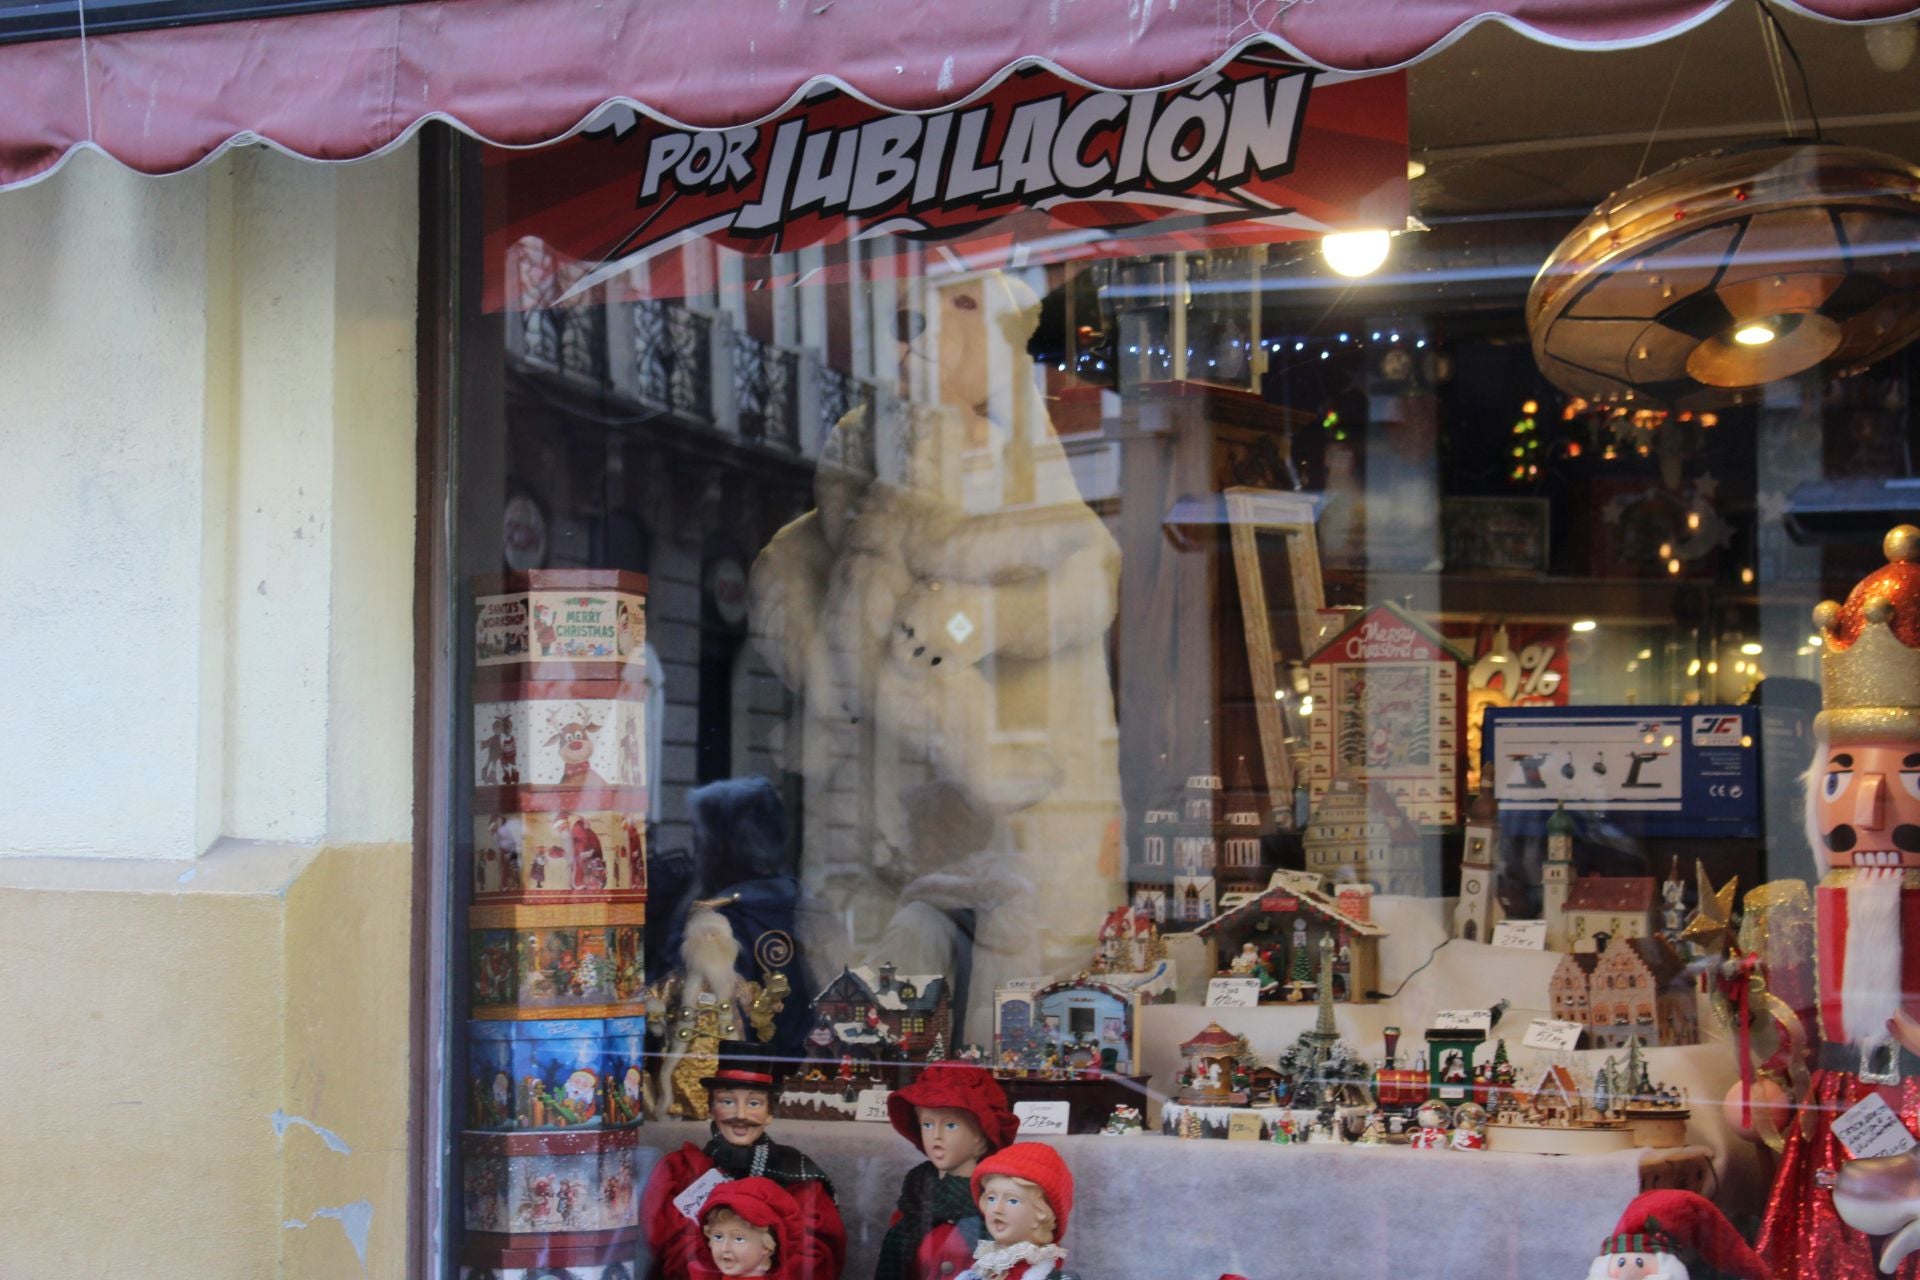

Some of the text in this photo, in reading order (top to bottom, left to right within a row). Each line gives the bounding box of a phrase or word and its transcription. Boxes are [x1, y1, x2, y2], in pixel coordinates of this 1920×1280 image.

[638, 70, 1309, 232] POR JUBILACIÓN
[565, 610, 603, 624] MERRY
[555, 625, 616, 639] CHRISTMAS
